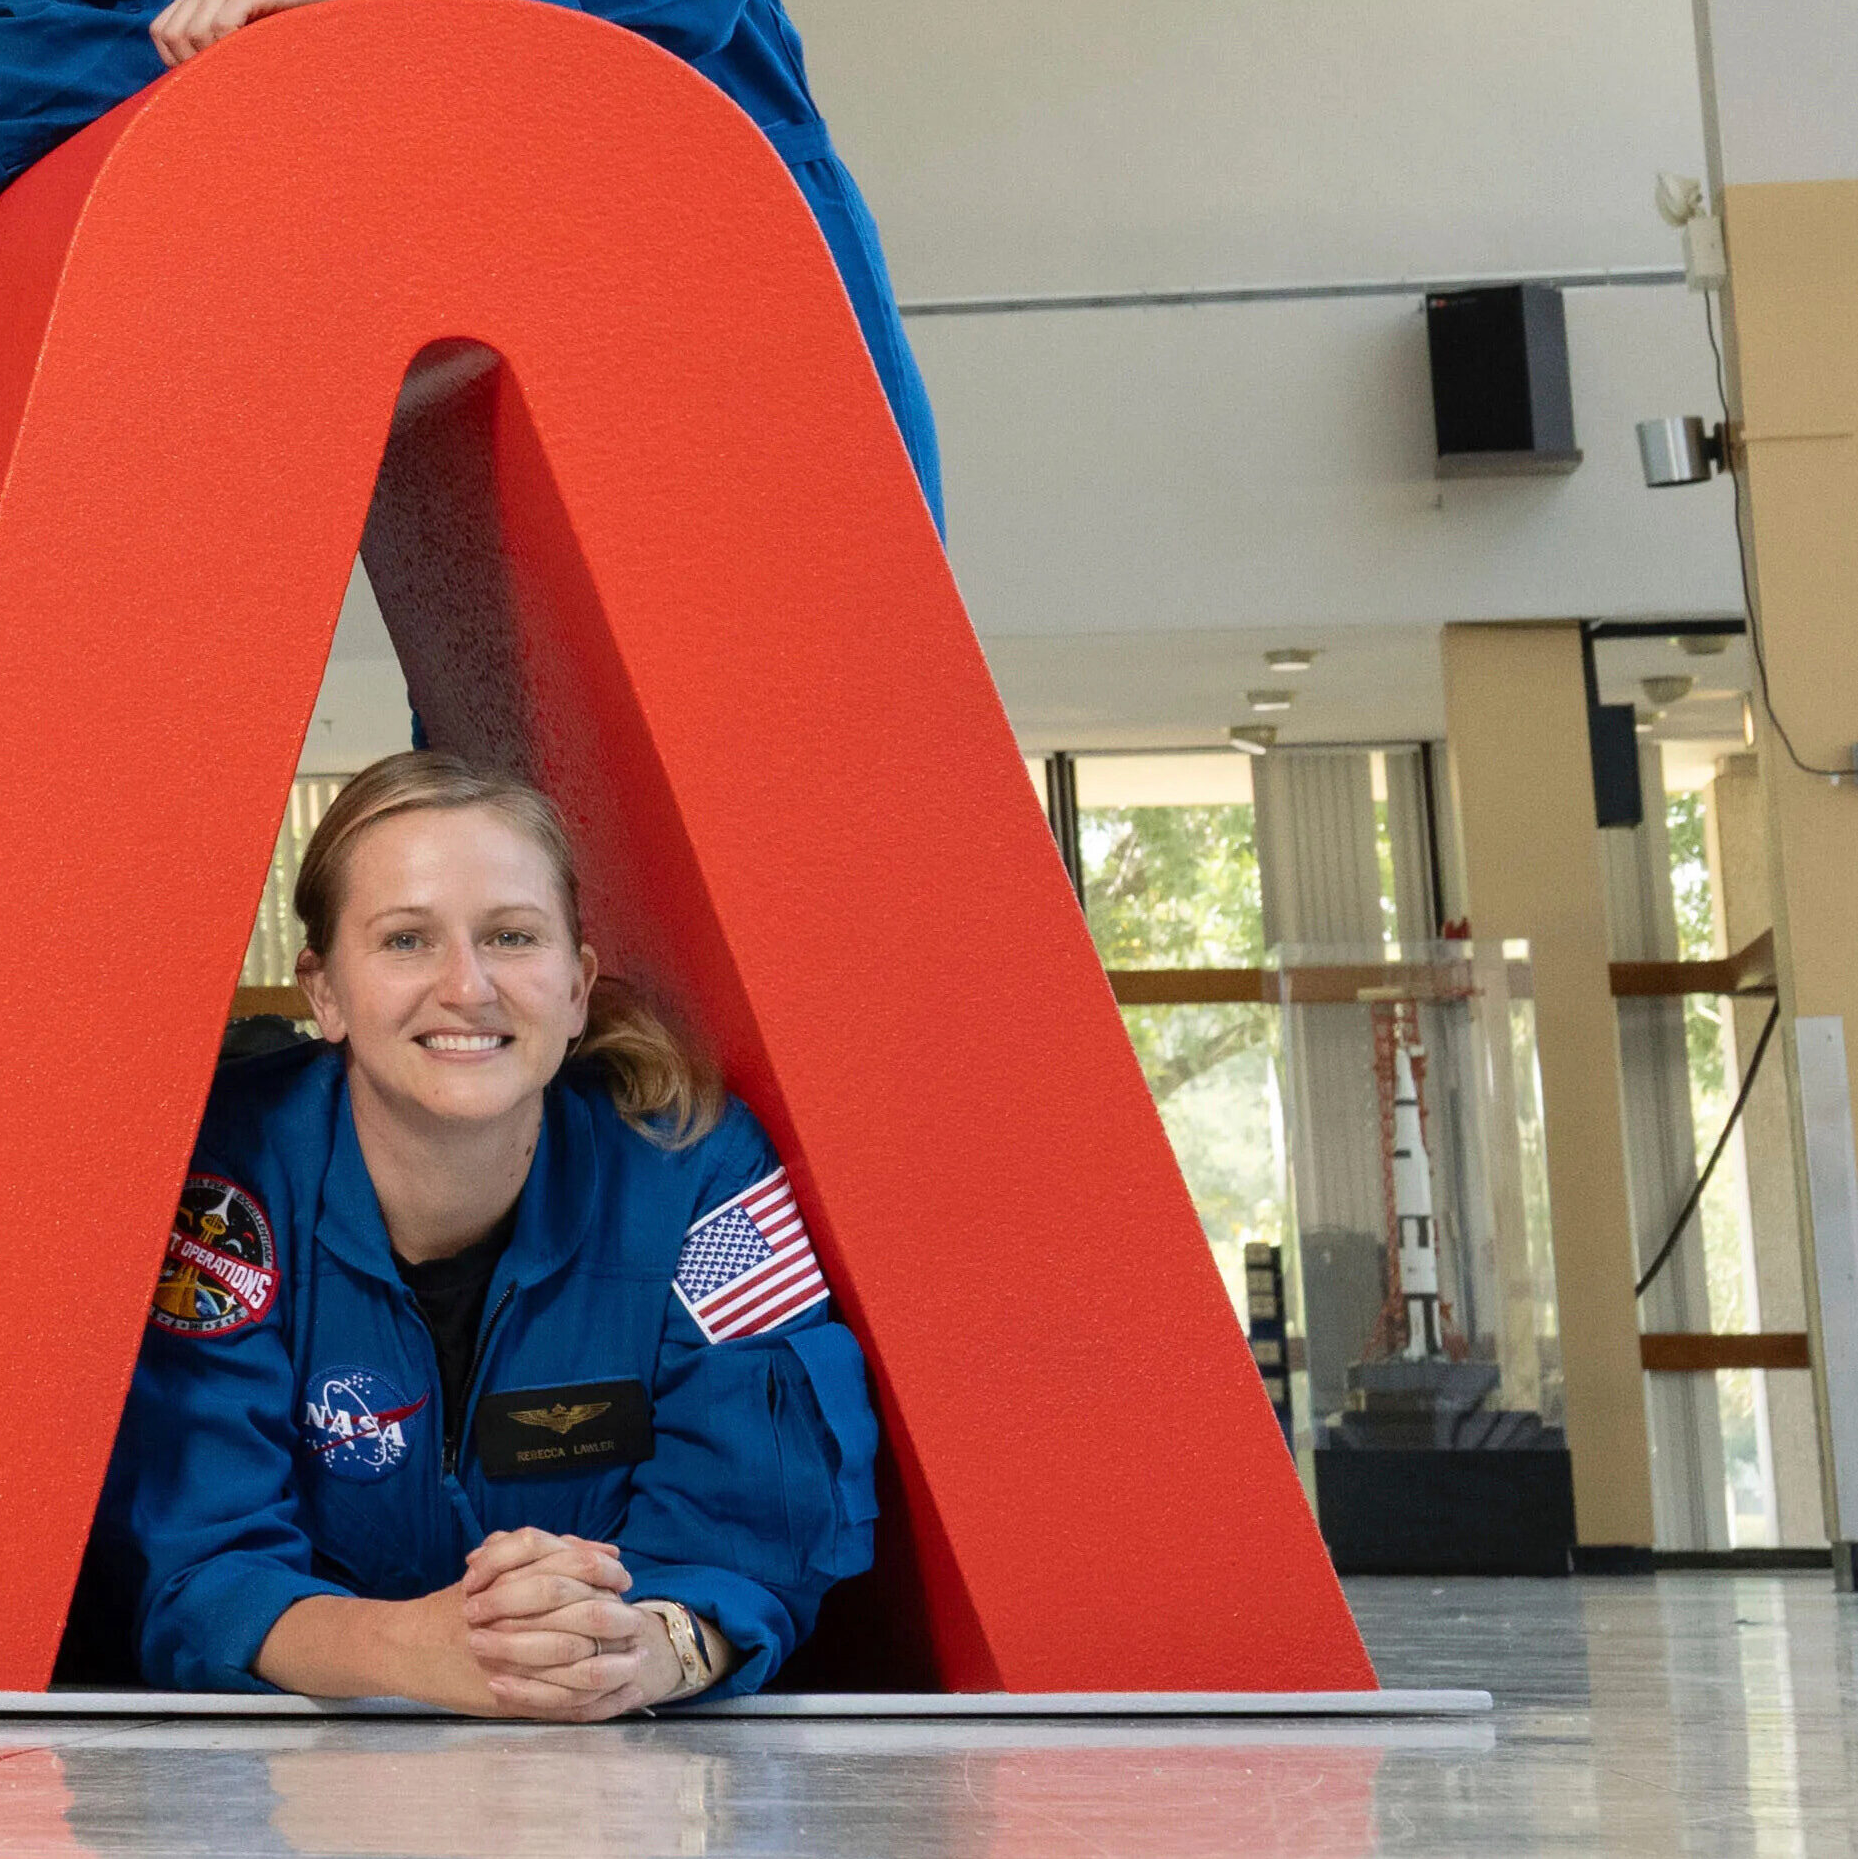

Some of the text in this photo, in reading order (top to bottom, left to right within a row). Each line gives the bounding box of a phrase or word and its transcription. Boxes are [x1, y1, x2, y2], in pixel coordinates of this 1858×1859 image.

[181, 1241, 273, 1310] OPERATIONS
[304, 1402, 407, 1448] NASA
[517, 1440, 615, 1462] REBECCA LAWLER
